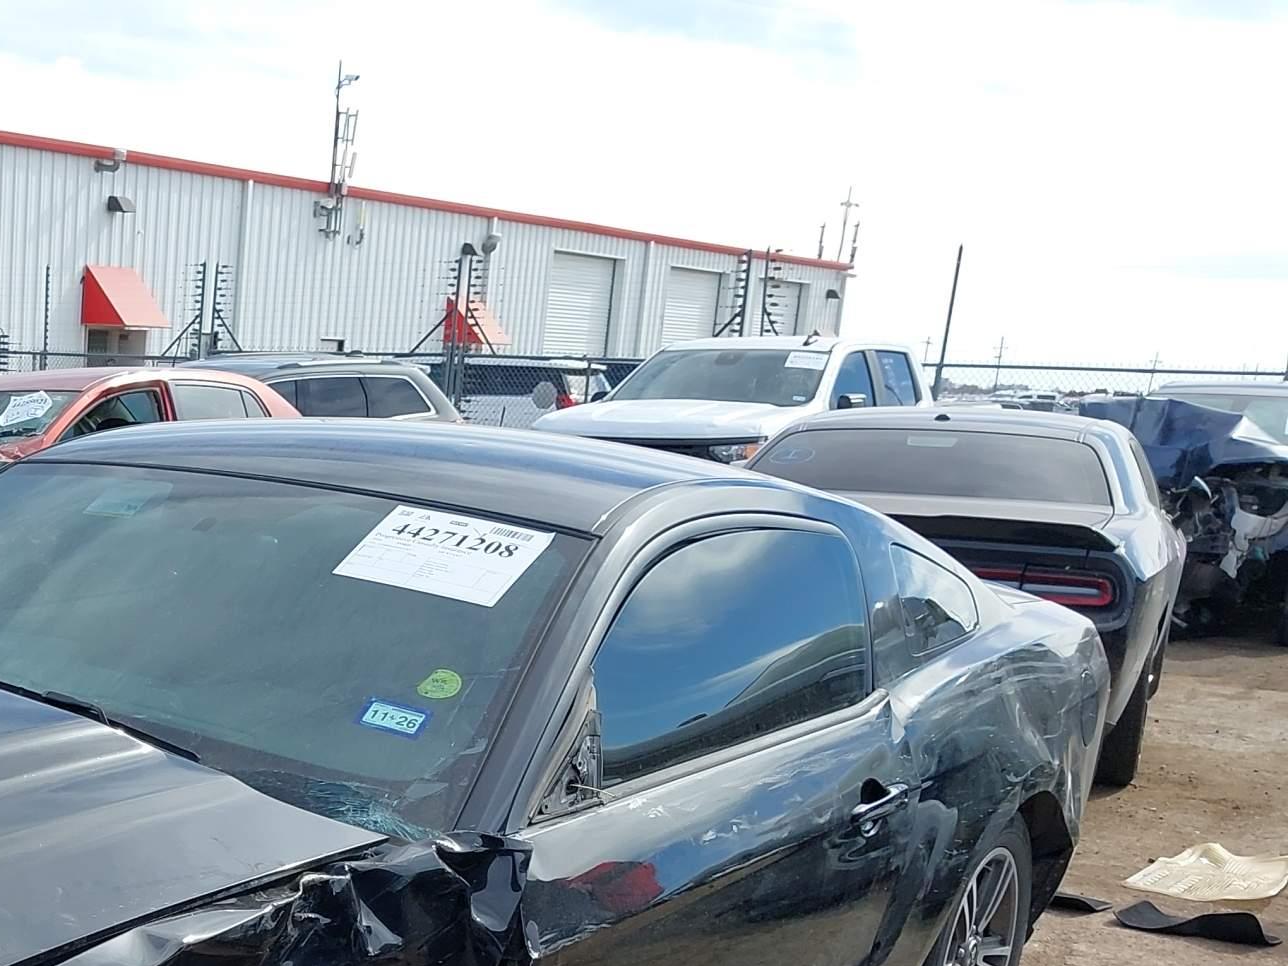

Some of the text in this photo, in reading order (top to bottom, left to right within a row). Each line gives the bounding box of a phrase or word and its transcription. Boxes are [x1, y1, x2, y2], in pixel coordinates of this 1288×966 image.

[392, 523, 519, 558] 44271208
[371, 709, 389, 722] 11
[395, 715, 418, 729] 26
